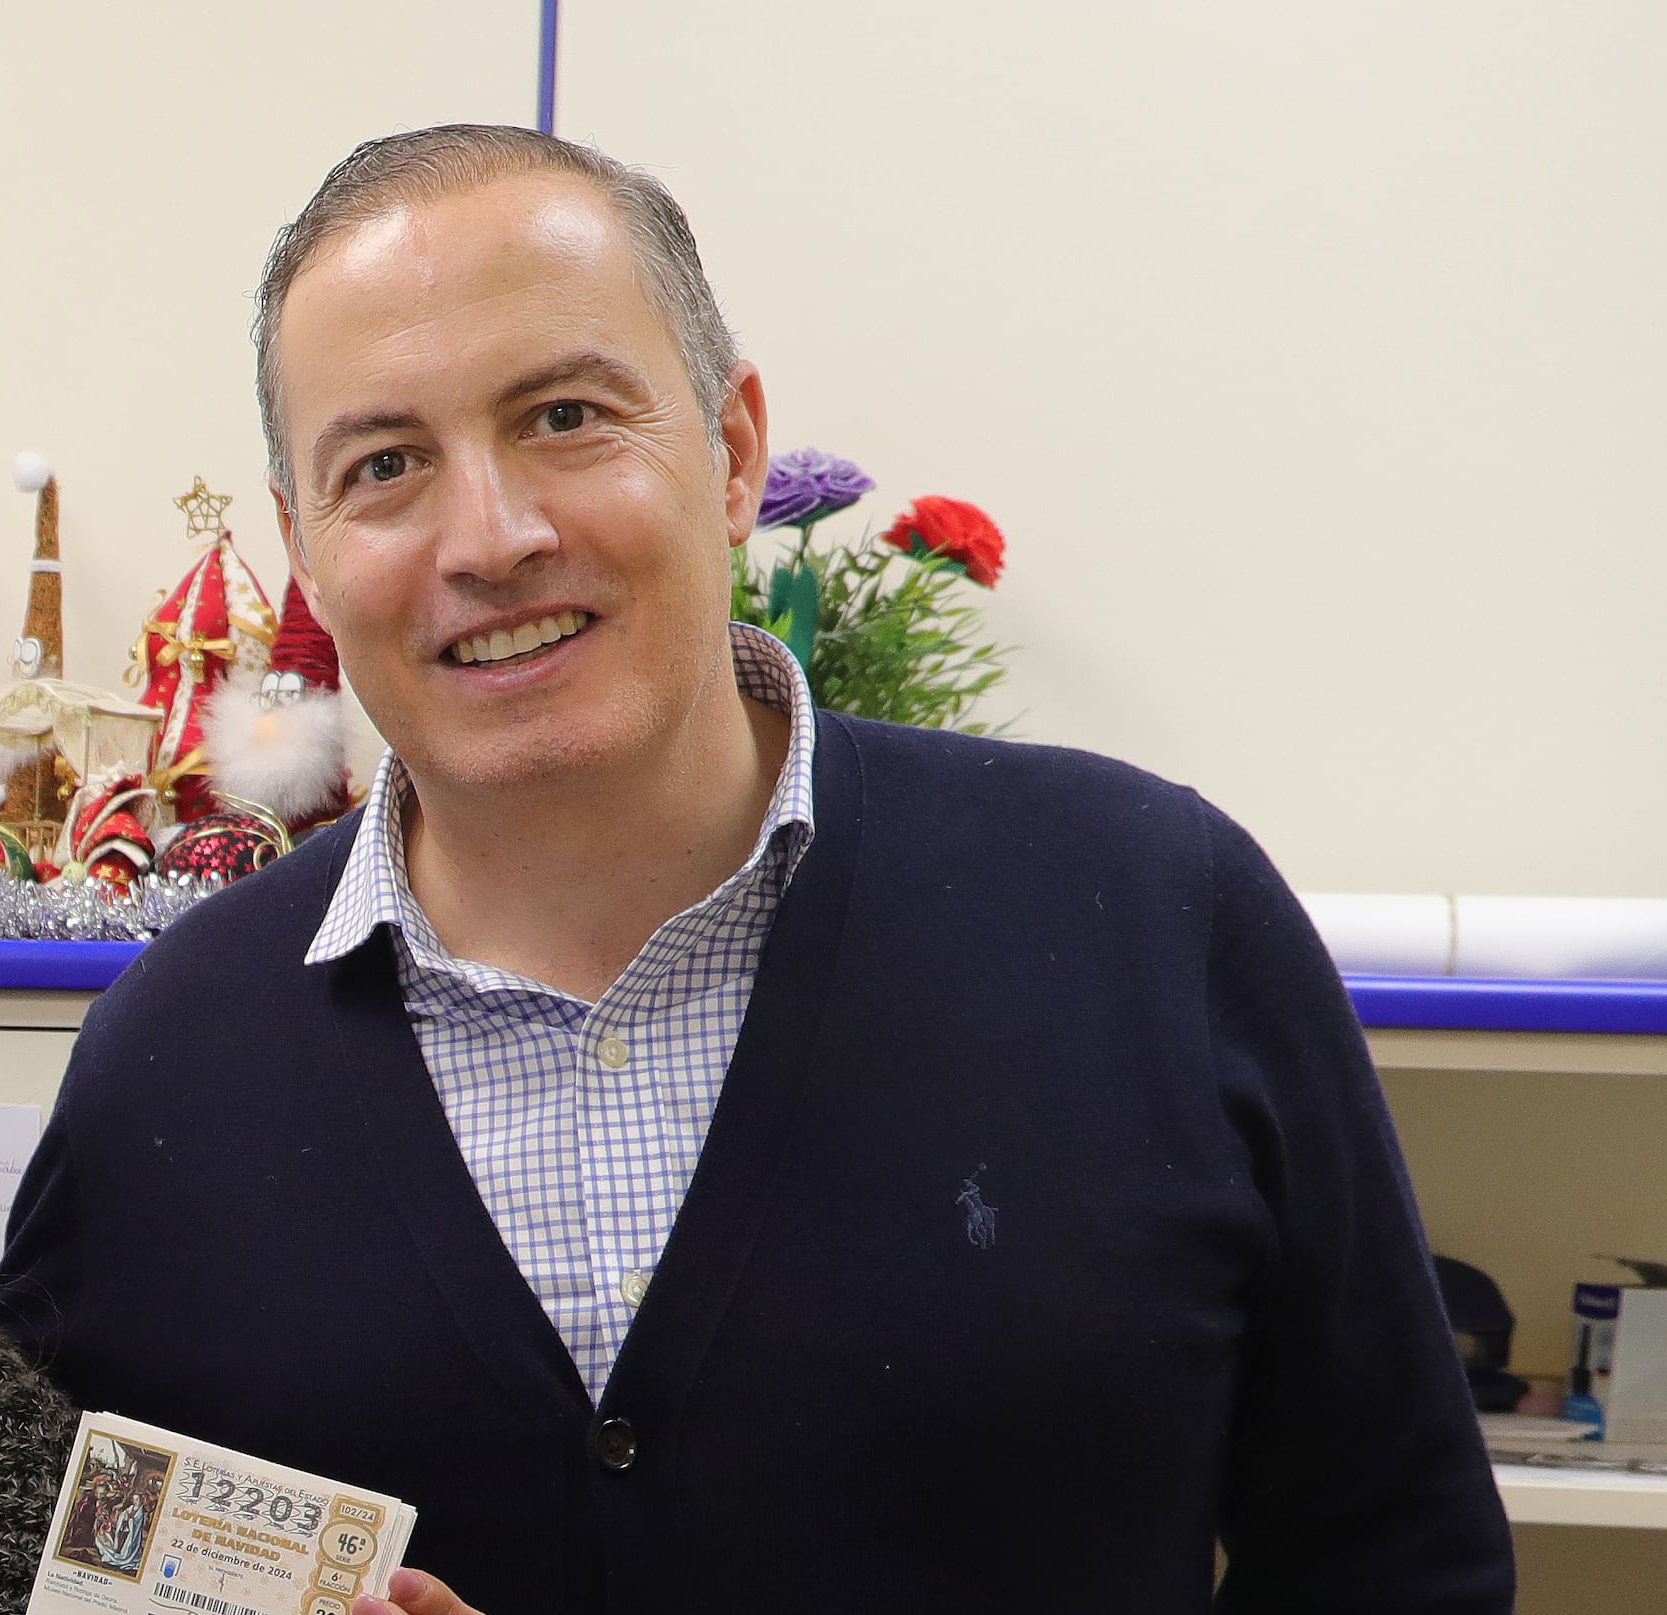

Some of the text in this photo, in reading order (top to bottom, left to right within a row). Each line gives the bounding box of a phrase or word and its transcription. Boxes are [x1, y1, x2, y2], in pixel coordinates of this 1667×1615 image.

[190, 1470, 323, 1531] 12203
[340, 1505, 375, 1521] 102/24
[172, 1507, 309, 1555] LOTERÍA NACIONAL
[192, 1529, 281, 1562] DE NAVIDAD
[171, 1539, 293, 1581] 22 de diciembre de 2024
[319, 1578, 351, 1594] FRACCIÓN
[318, 1598, 340, 1611] PRECIO
